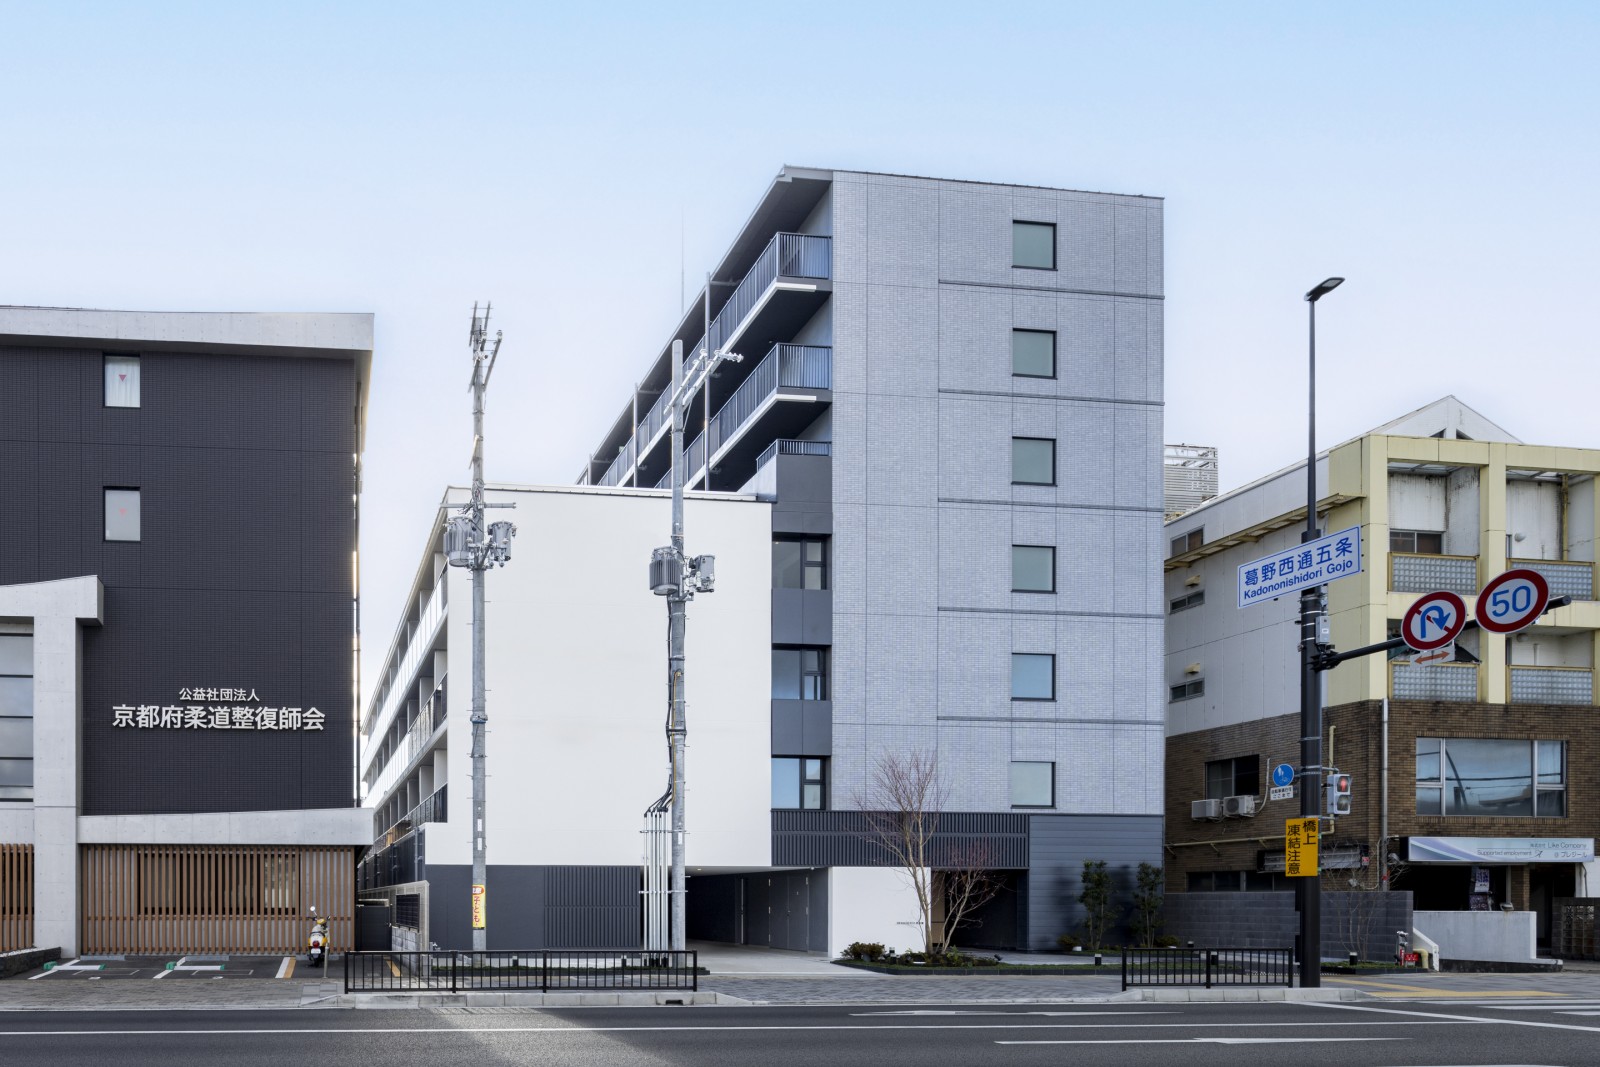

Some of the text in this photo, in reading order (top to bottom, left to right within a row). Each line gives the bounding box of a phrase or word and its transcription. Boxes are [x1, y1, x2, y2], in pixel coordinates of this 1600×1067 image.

[1244, 537, 1353, 586] 葛野西通五条
[1243, 559, 1353, 600] Kadononishidori Gojo
[1491, 585, 1531, 618] 50
[178, 687, 260, 702] 公益社団法人
[112, 703, 326, 731] 京都府柔道整復師会
[1302, 820, 1317, 845] 橋上
[1560, 842, 1587, 850] Company
[1287, 824, 1301, 875] 凍結注意
